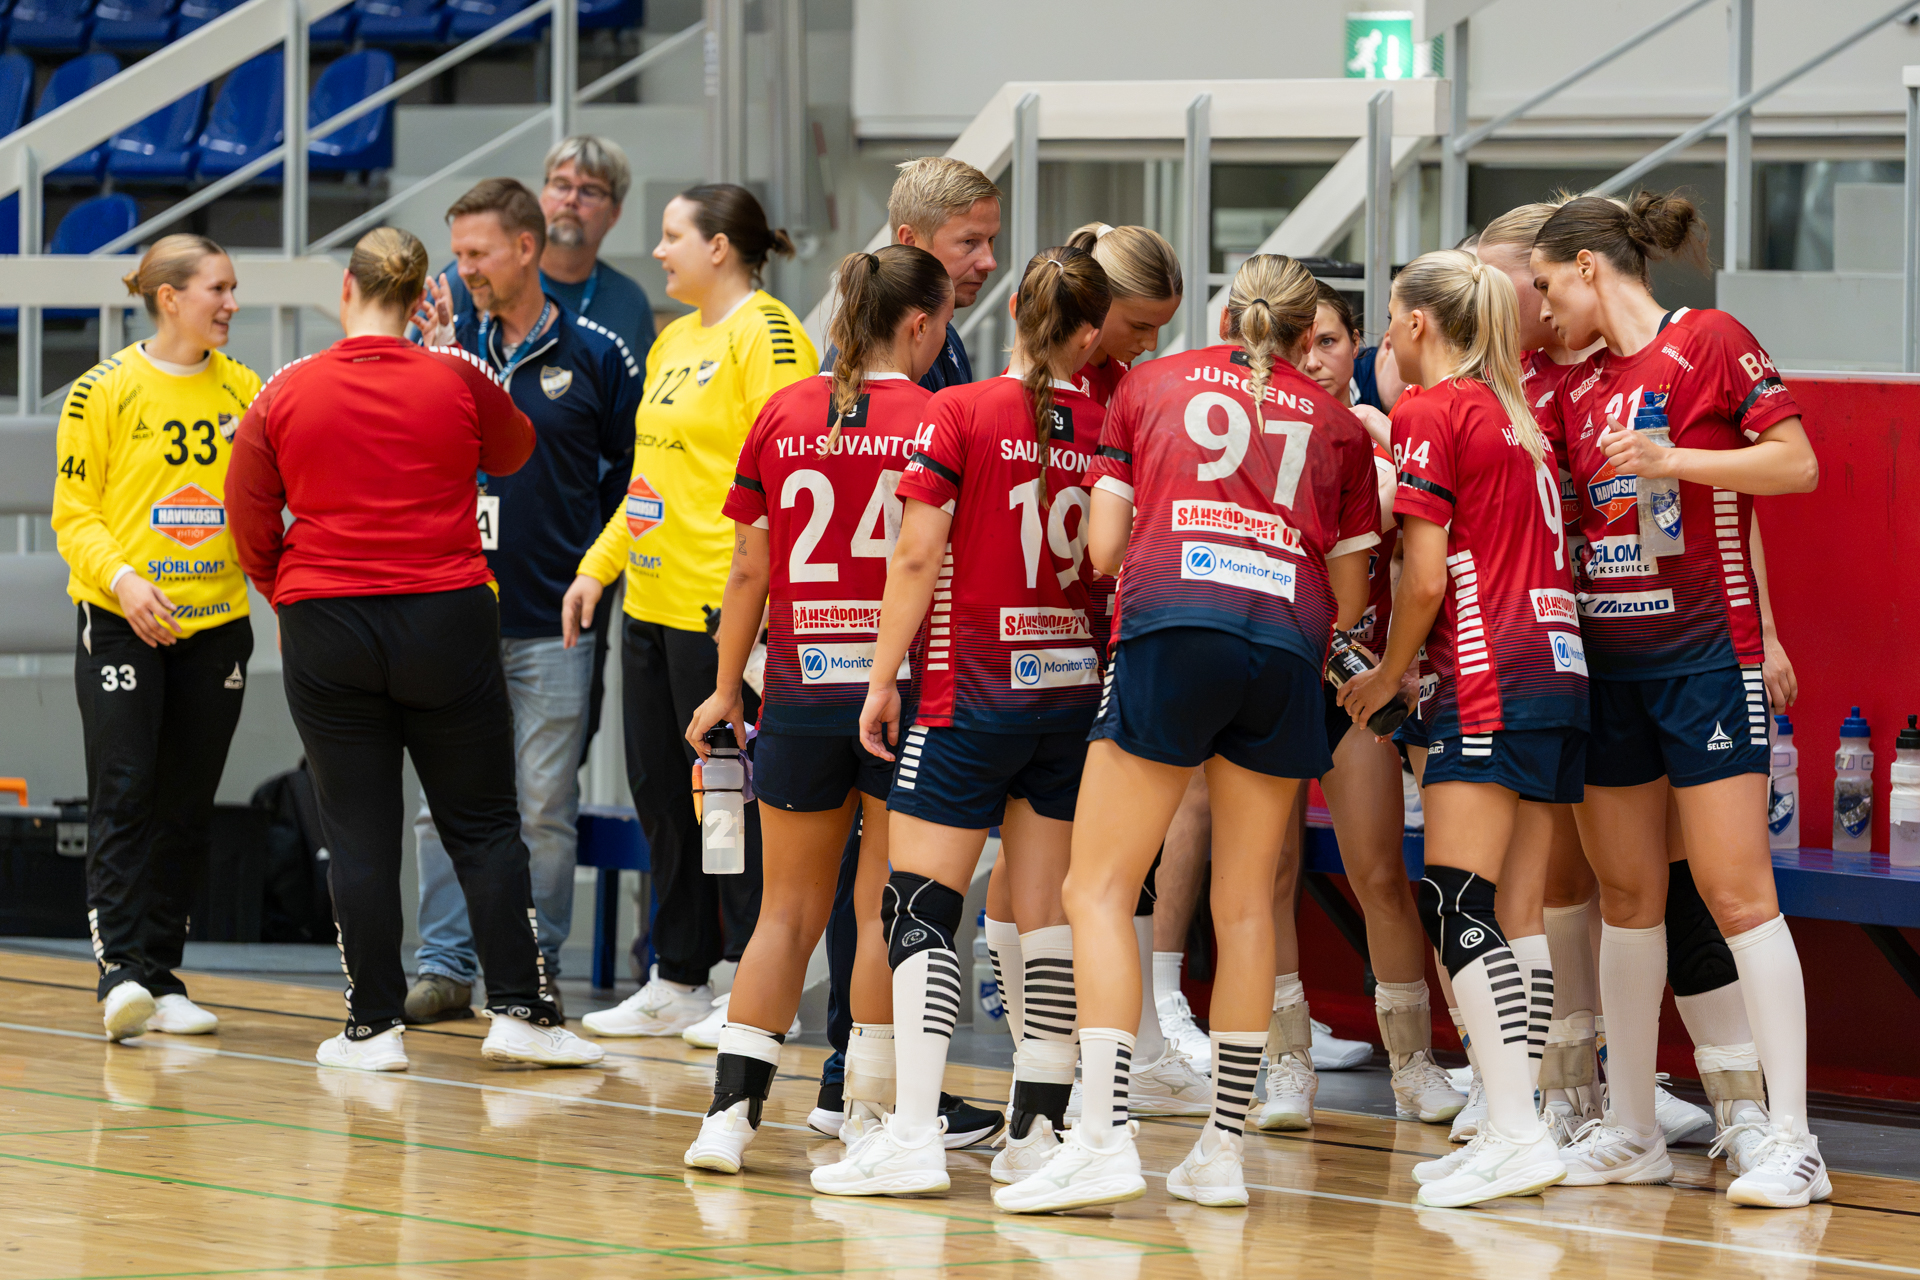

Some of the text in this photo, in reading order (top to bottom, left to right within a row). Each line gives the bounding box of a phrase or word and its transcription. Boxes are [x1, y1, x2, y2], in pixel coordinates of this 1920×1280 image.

[1738, 350, 1777, 382] B4
[650, 367, 690, 405] 12
[163, 419, 217, 466] 33
[1001, 438, 1092, 474] SAUKON
[1184, 392, 1314, 511] 97
[60, 455, 86, 481] 44
[158, 508, 221, 524] HAVUKOSKI
[781, 469, 903, 583] 24
[1536, 461, 1564, 571] 9
[1009, 478, 1090, 590] 19
[1220, 558, 1270, 578] Monitor
[101, 664, 137, 692] 33
[831, 656, 873, 669] Monito
[1044, 657, 1098, 673] Monitor ERP
[1707, 741, 1733, 751] SELECT
